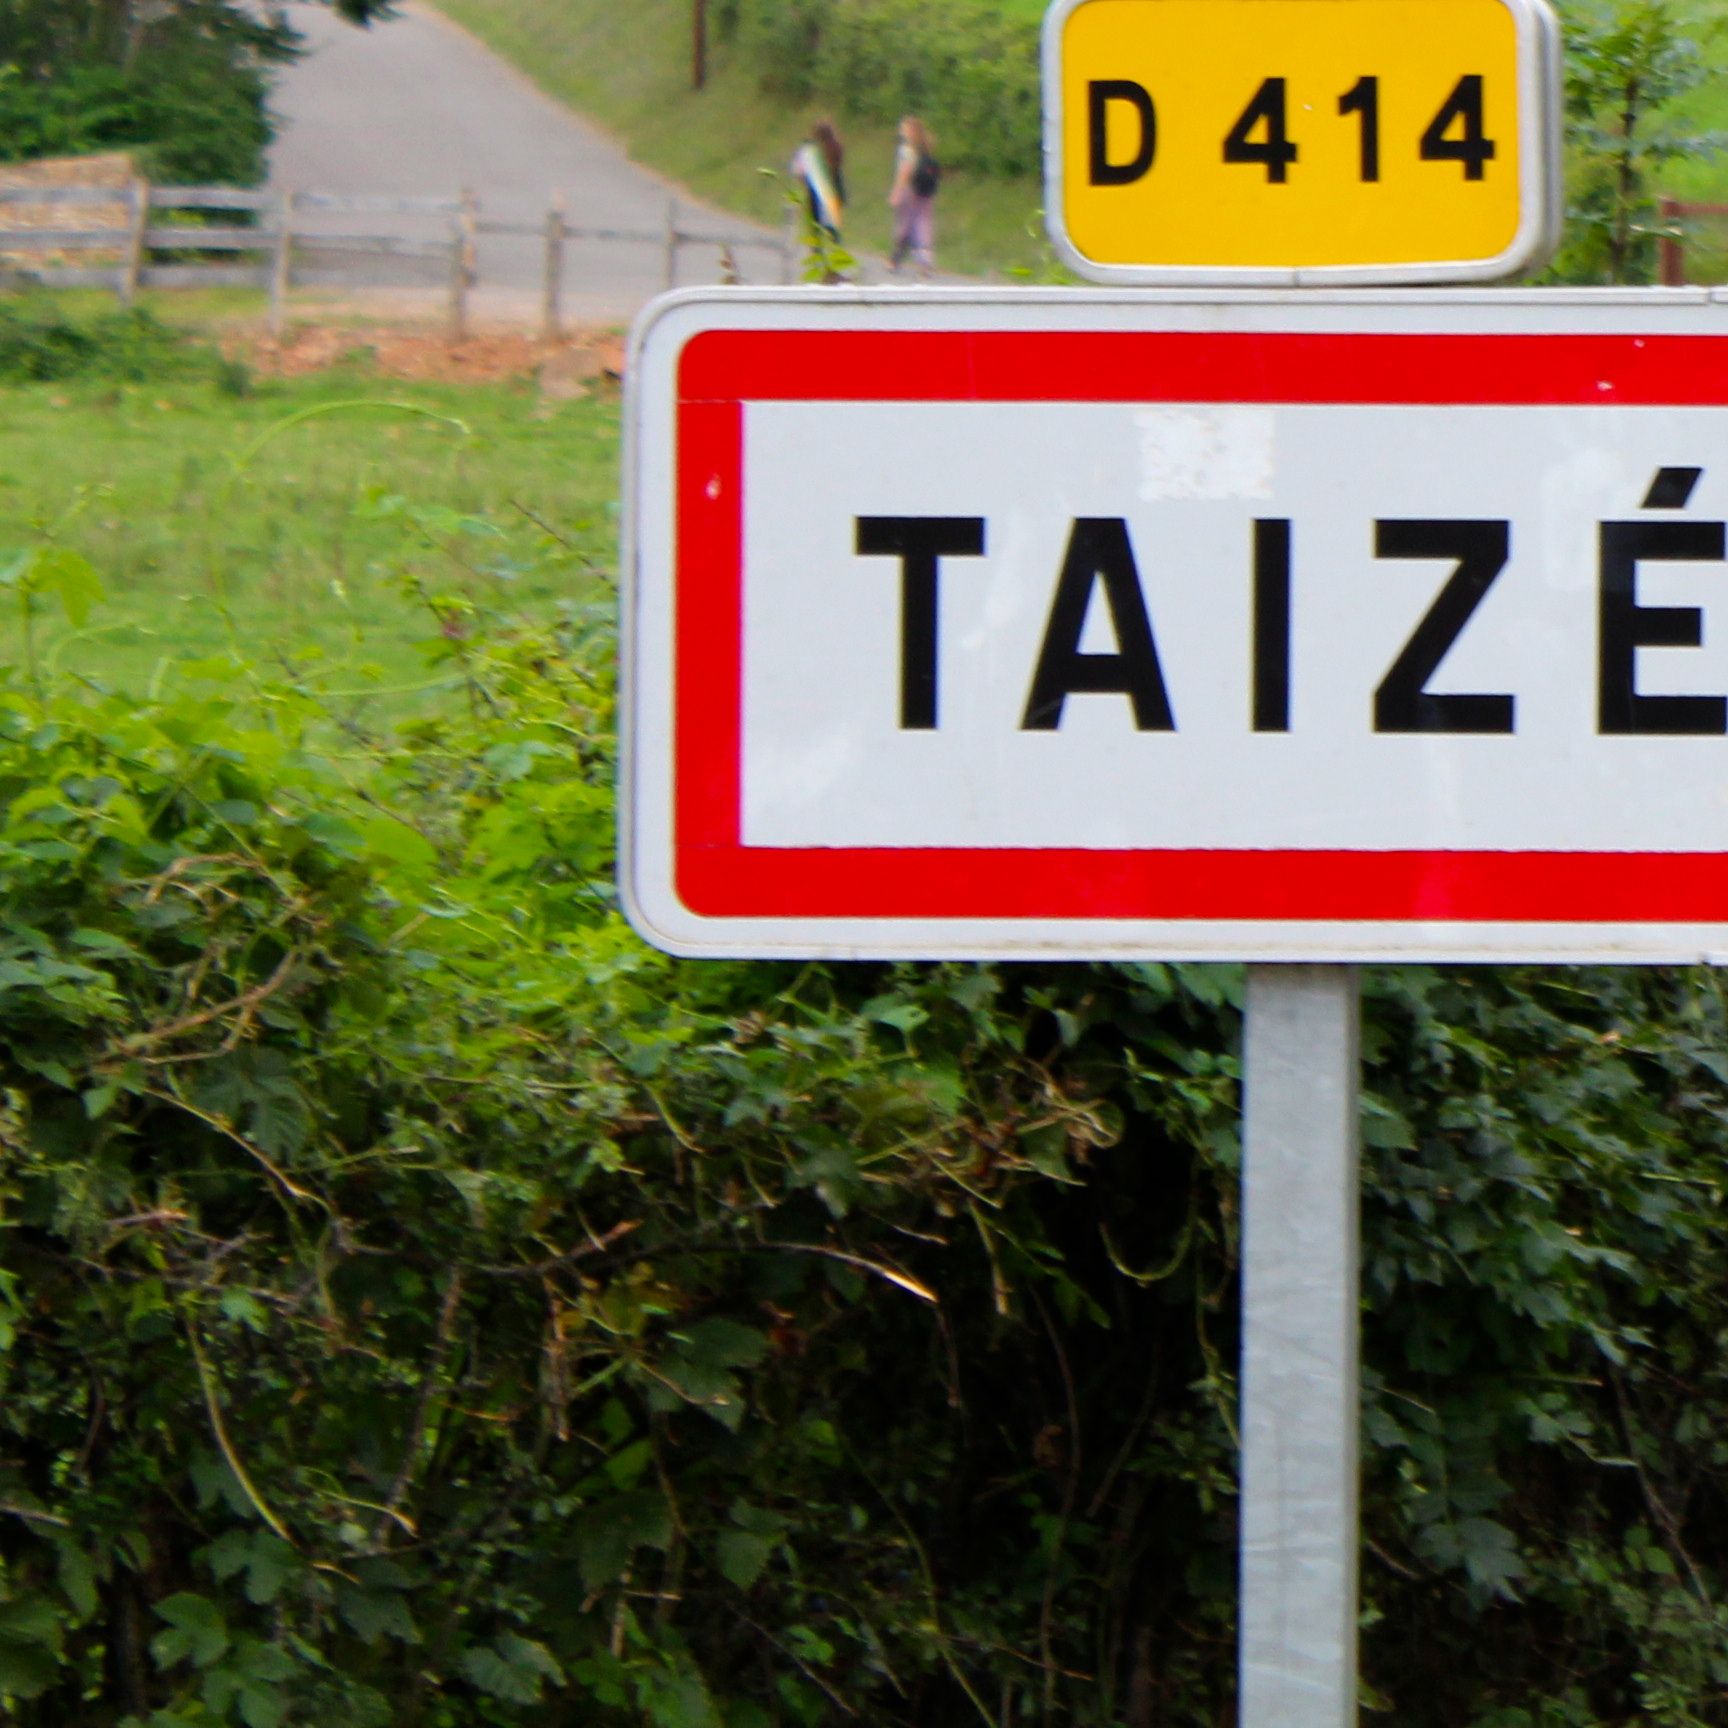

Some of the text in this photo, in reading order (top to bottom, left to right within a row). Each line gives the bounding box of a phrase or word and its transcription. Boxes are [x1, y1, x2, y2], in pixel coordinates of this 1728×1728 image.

[1087, 74, 1496, 186] D 414
[855, 467, 1728, 736] TAIZÉ
